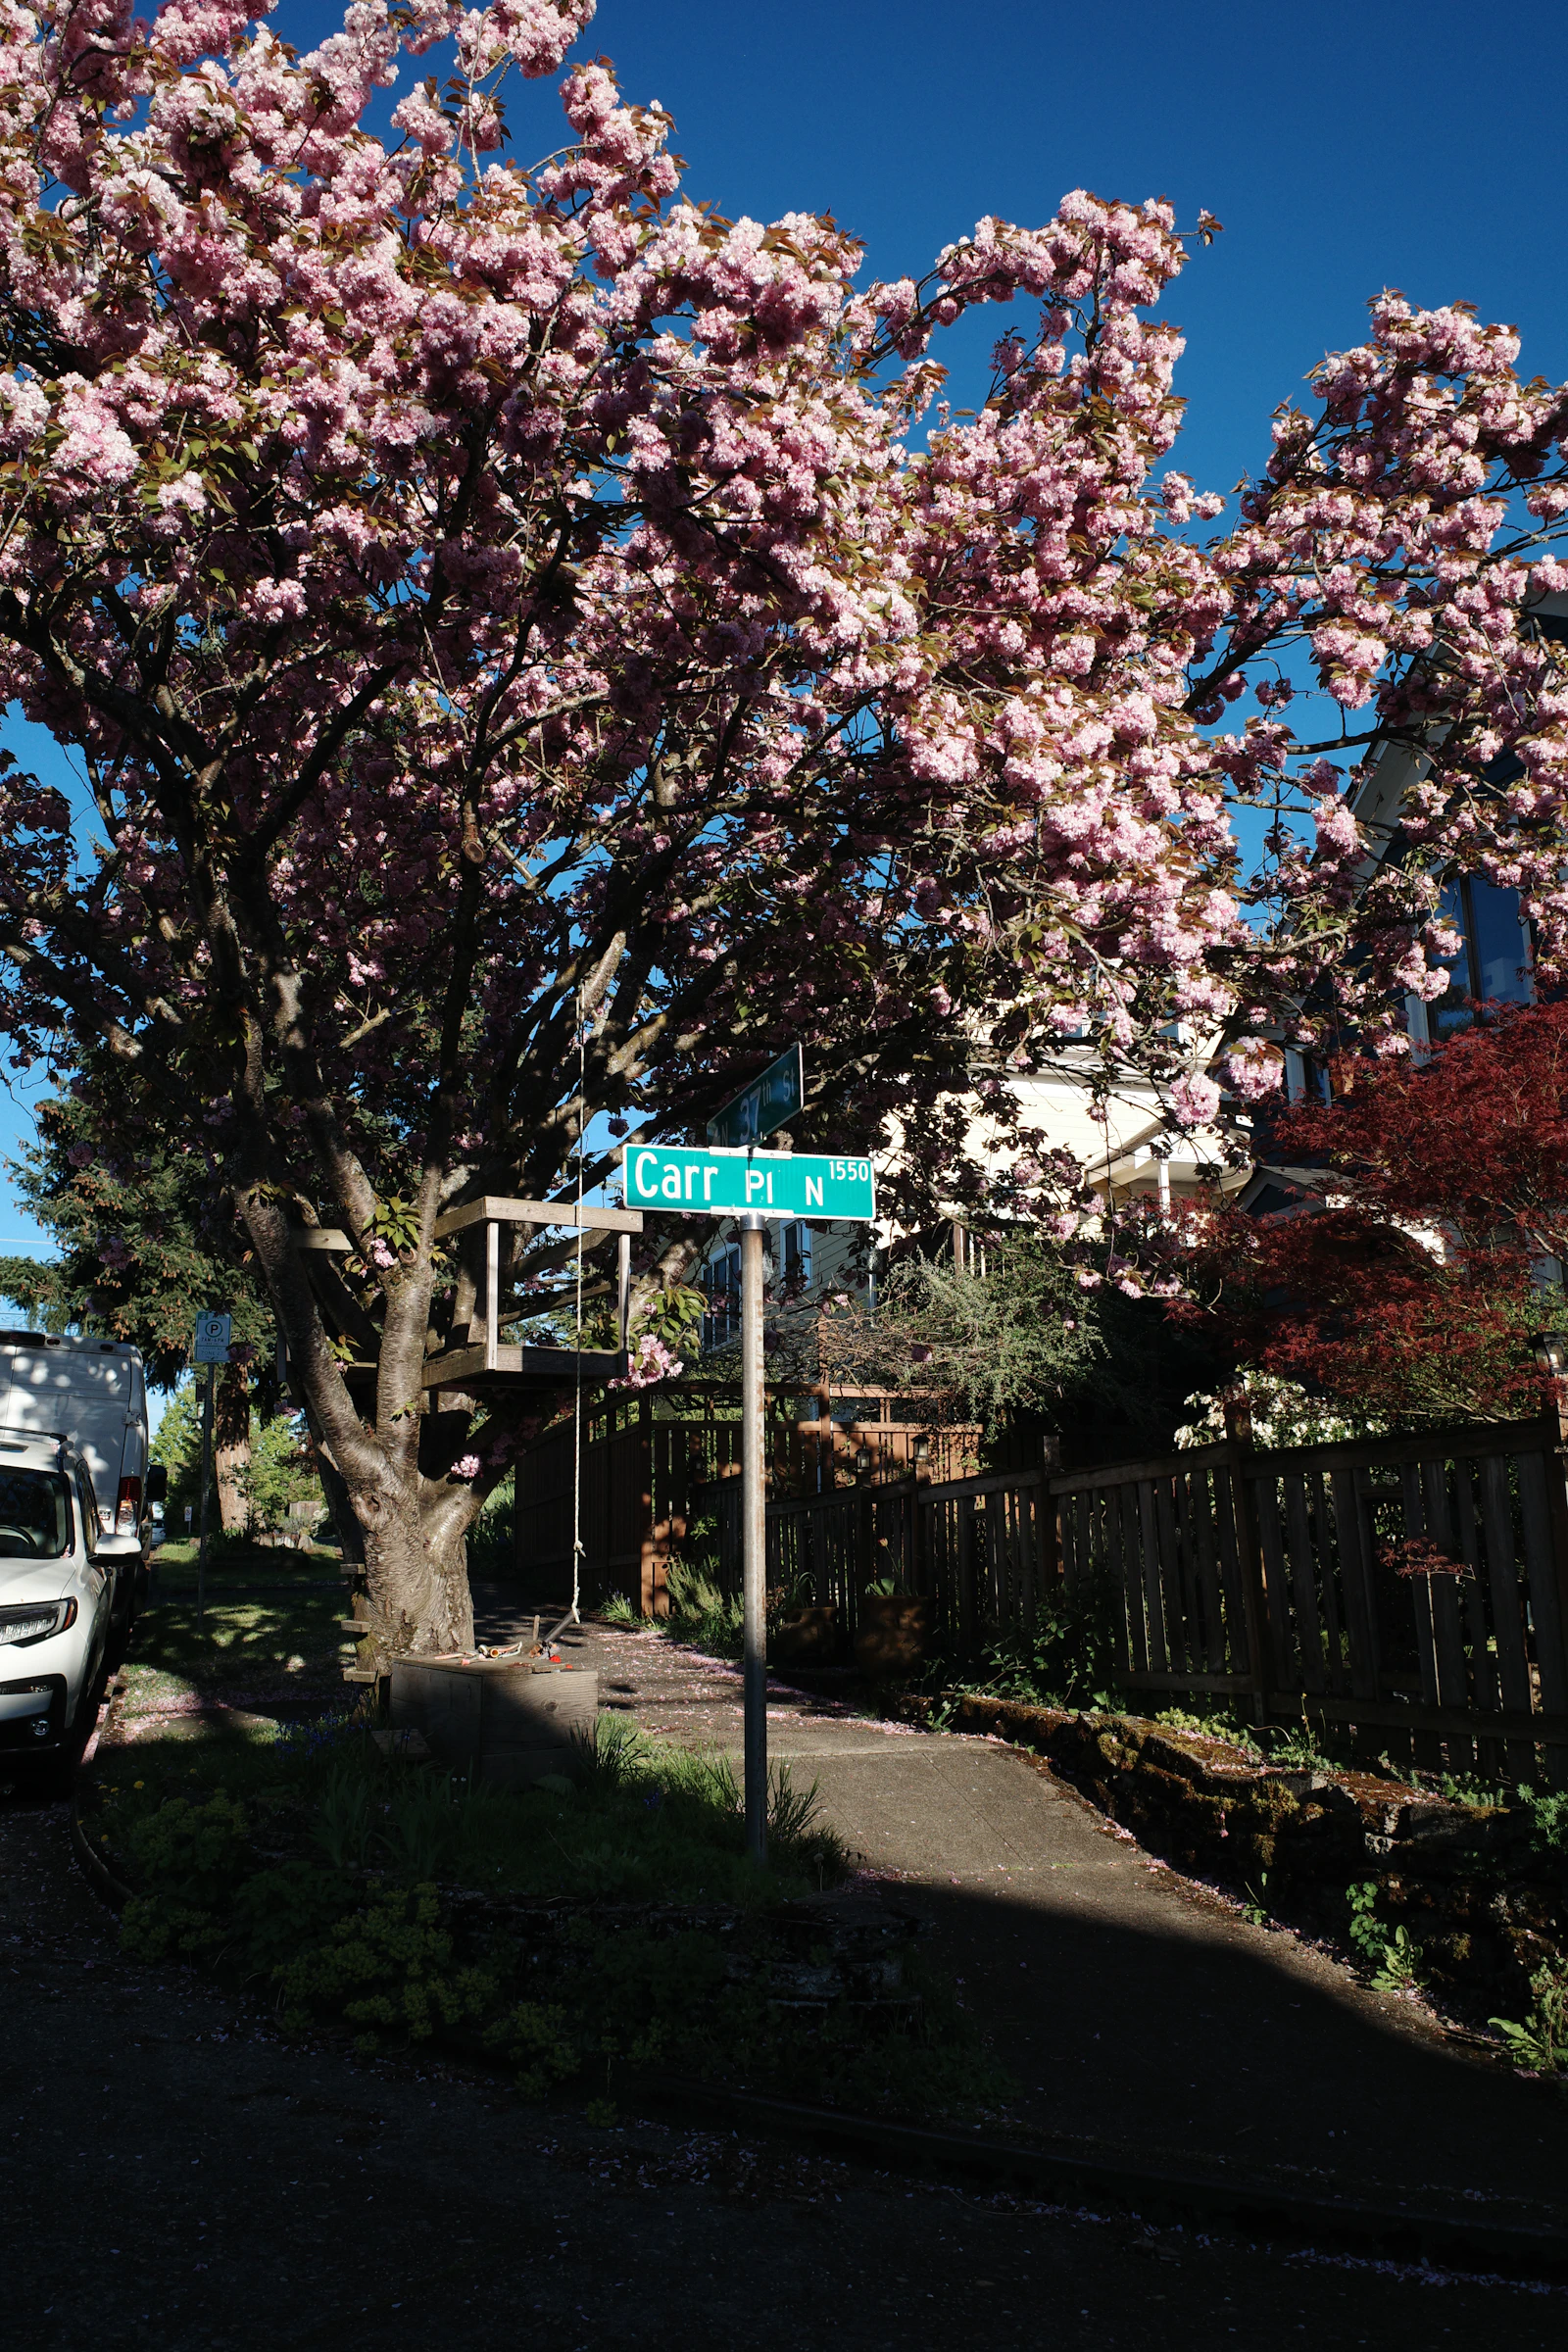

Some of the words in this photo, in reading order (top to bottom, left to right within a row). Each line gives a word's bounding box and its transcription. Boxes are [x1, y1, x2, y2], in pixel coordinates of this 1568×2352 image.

[721, 1121, 728, 1148] N
[740, 1080, 772, 1144] 37th
[782, 1067, 796, 1102] St
[634, 1152, 718, 1201] Carr
[745, 1169, 773, 1204] Pl
[805, 1176, 824, 1206] N
[829, 1160, 869, 1182] 1550
[211, 1325, 219, 1334] P
